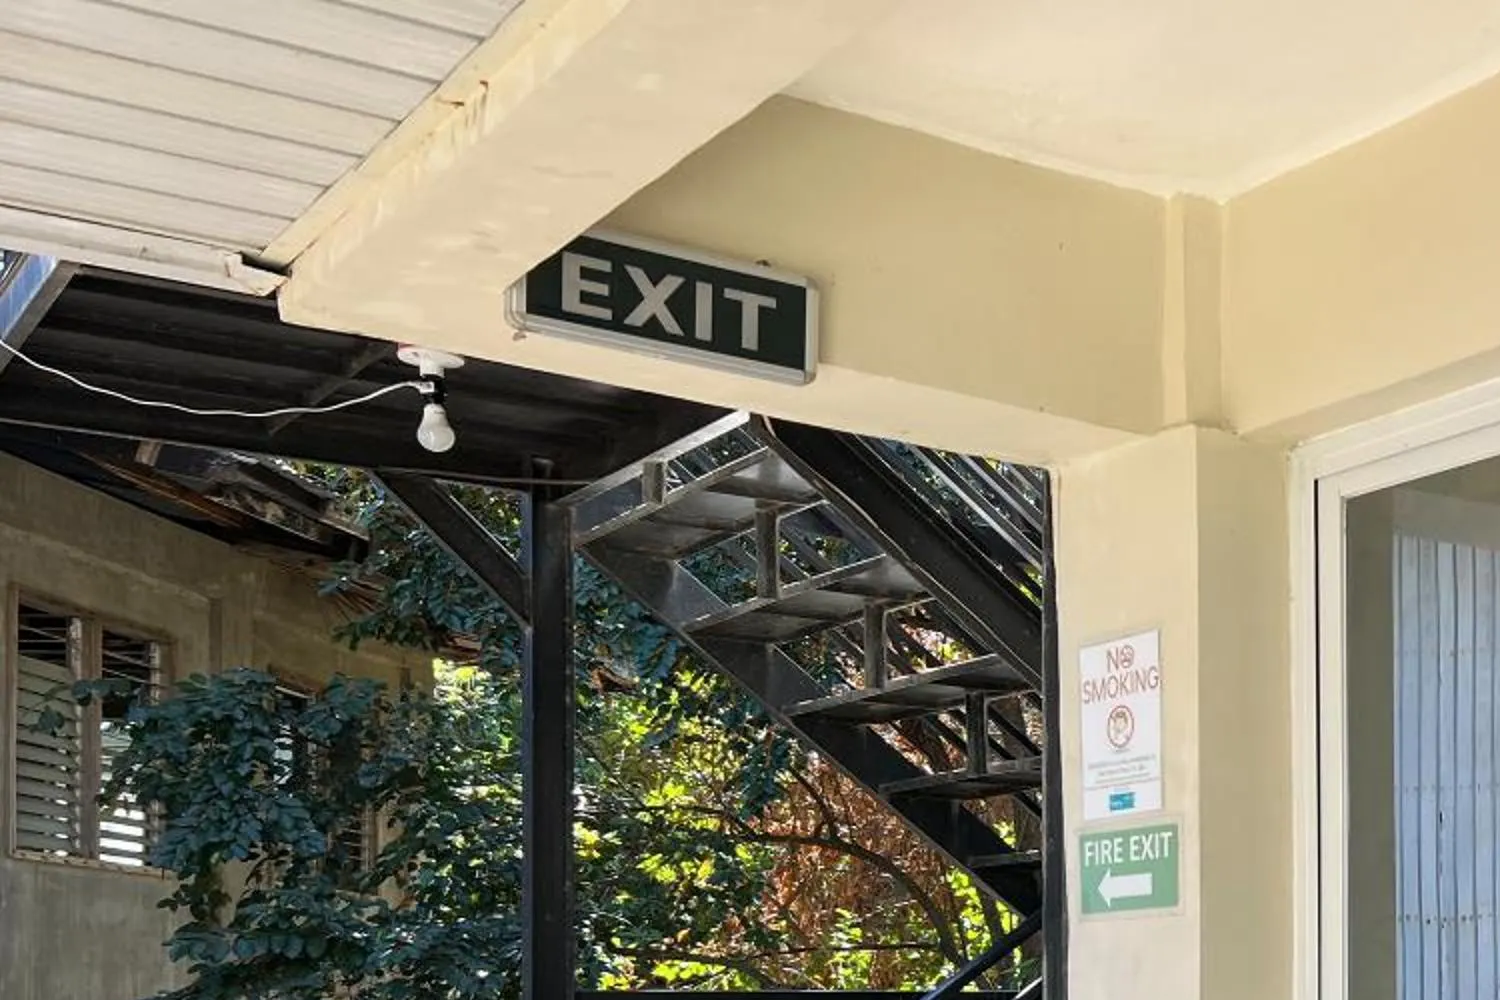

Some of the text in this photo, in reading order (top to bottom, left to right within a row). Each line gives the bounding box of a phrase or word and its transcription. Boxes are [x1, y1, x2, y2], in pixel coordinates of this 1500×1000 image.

[561, 251, 777, 352] EXIT
[1106, 644, 1135, 672] NO
[1083, 666, 1159, 704] SMOKING
[1084, 831, 1173, 867] FIRE EXIT
